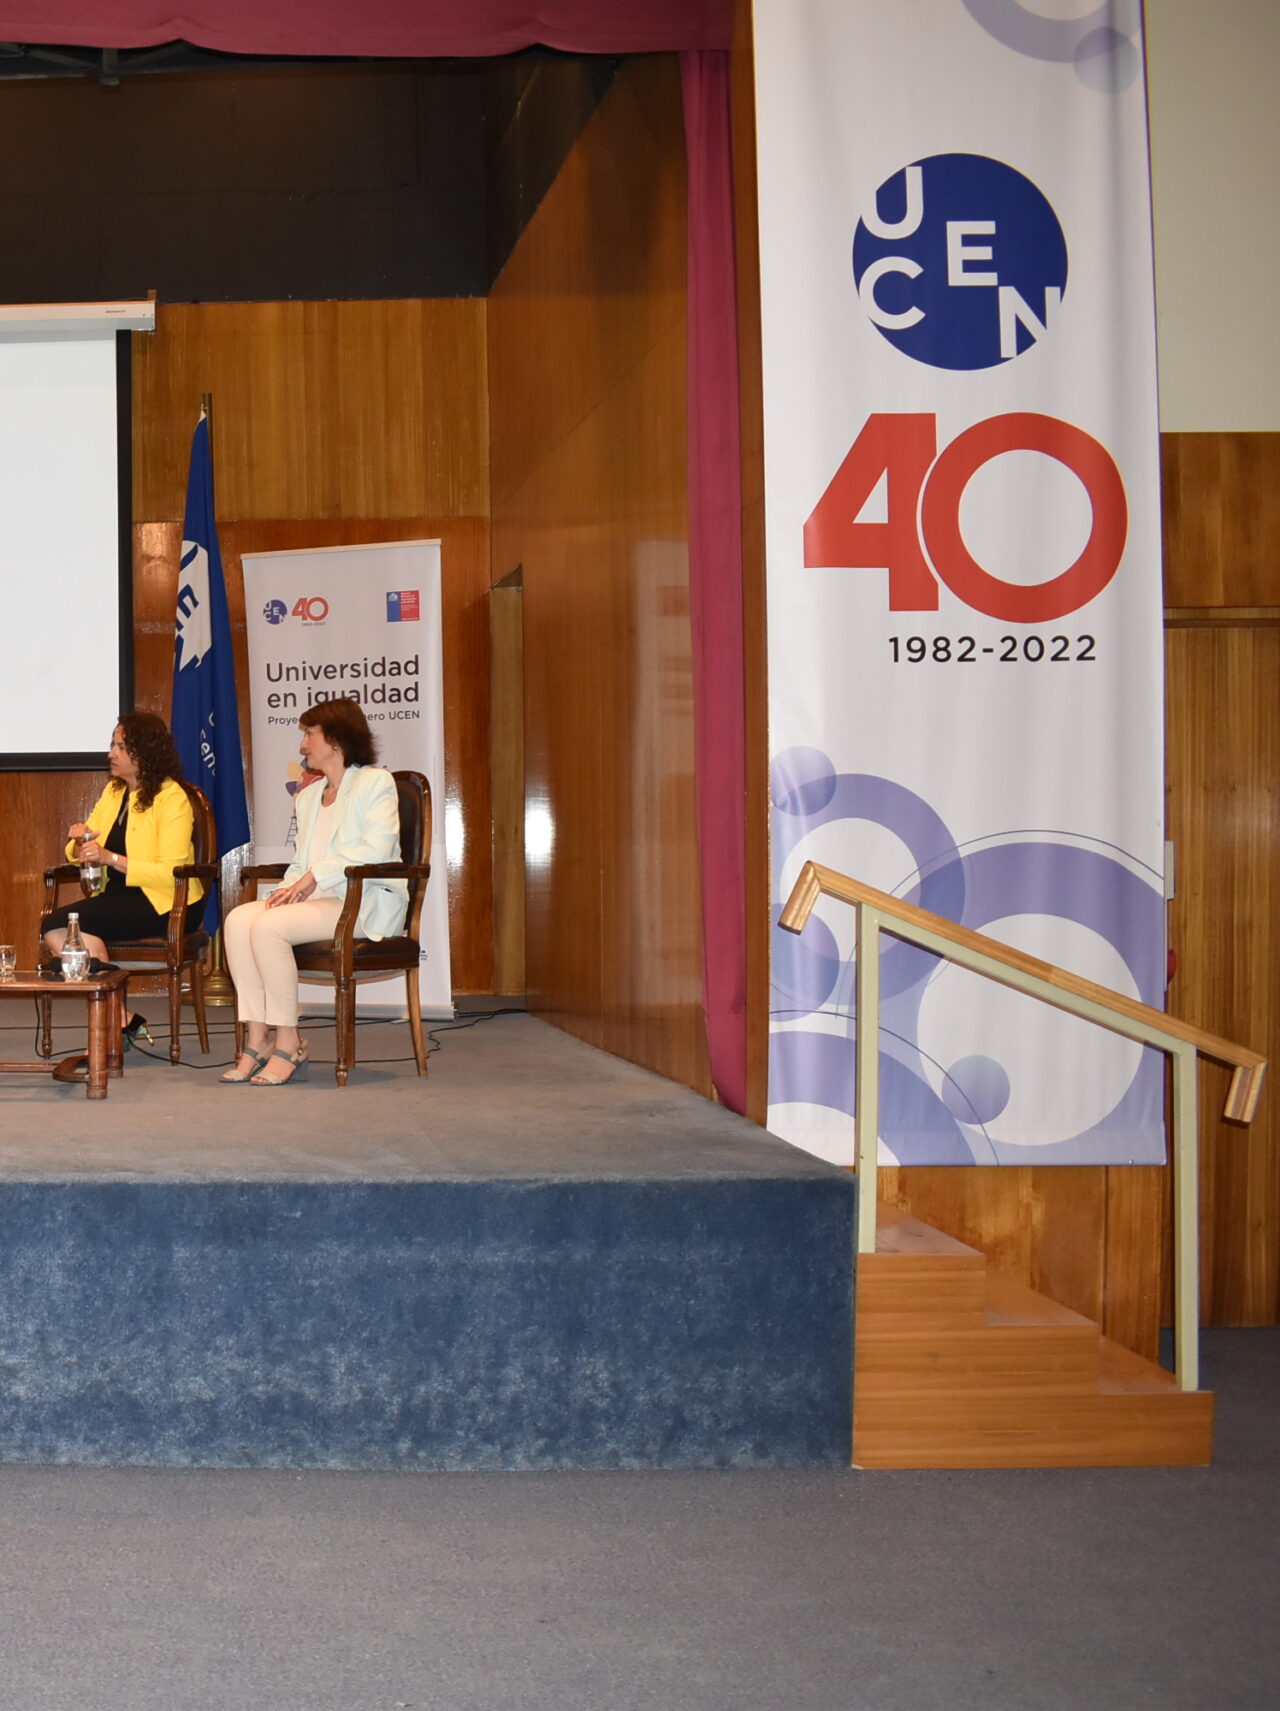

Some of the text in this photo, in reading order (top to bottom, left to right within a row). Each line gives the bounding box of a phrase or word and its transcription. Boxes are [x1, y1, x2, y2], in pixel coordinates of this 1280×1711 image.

[803, 411, 1129, 624] 40
[291, 596, 330, 622] 40
[887, 633, 1097, 664] 1982-2022
[265, 654, 420, 683] Universidad
[267, 691, 298, 709] en
[267, 715, 299, 727] Proye
[388, 709, 421, 720] UCEN
